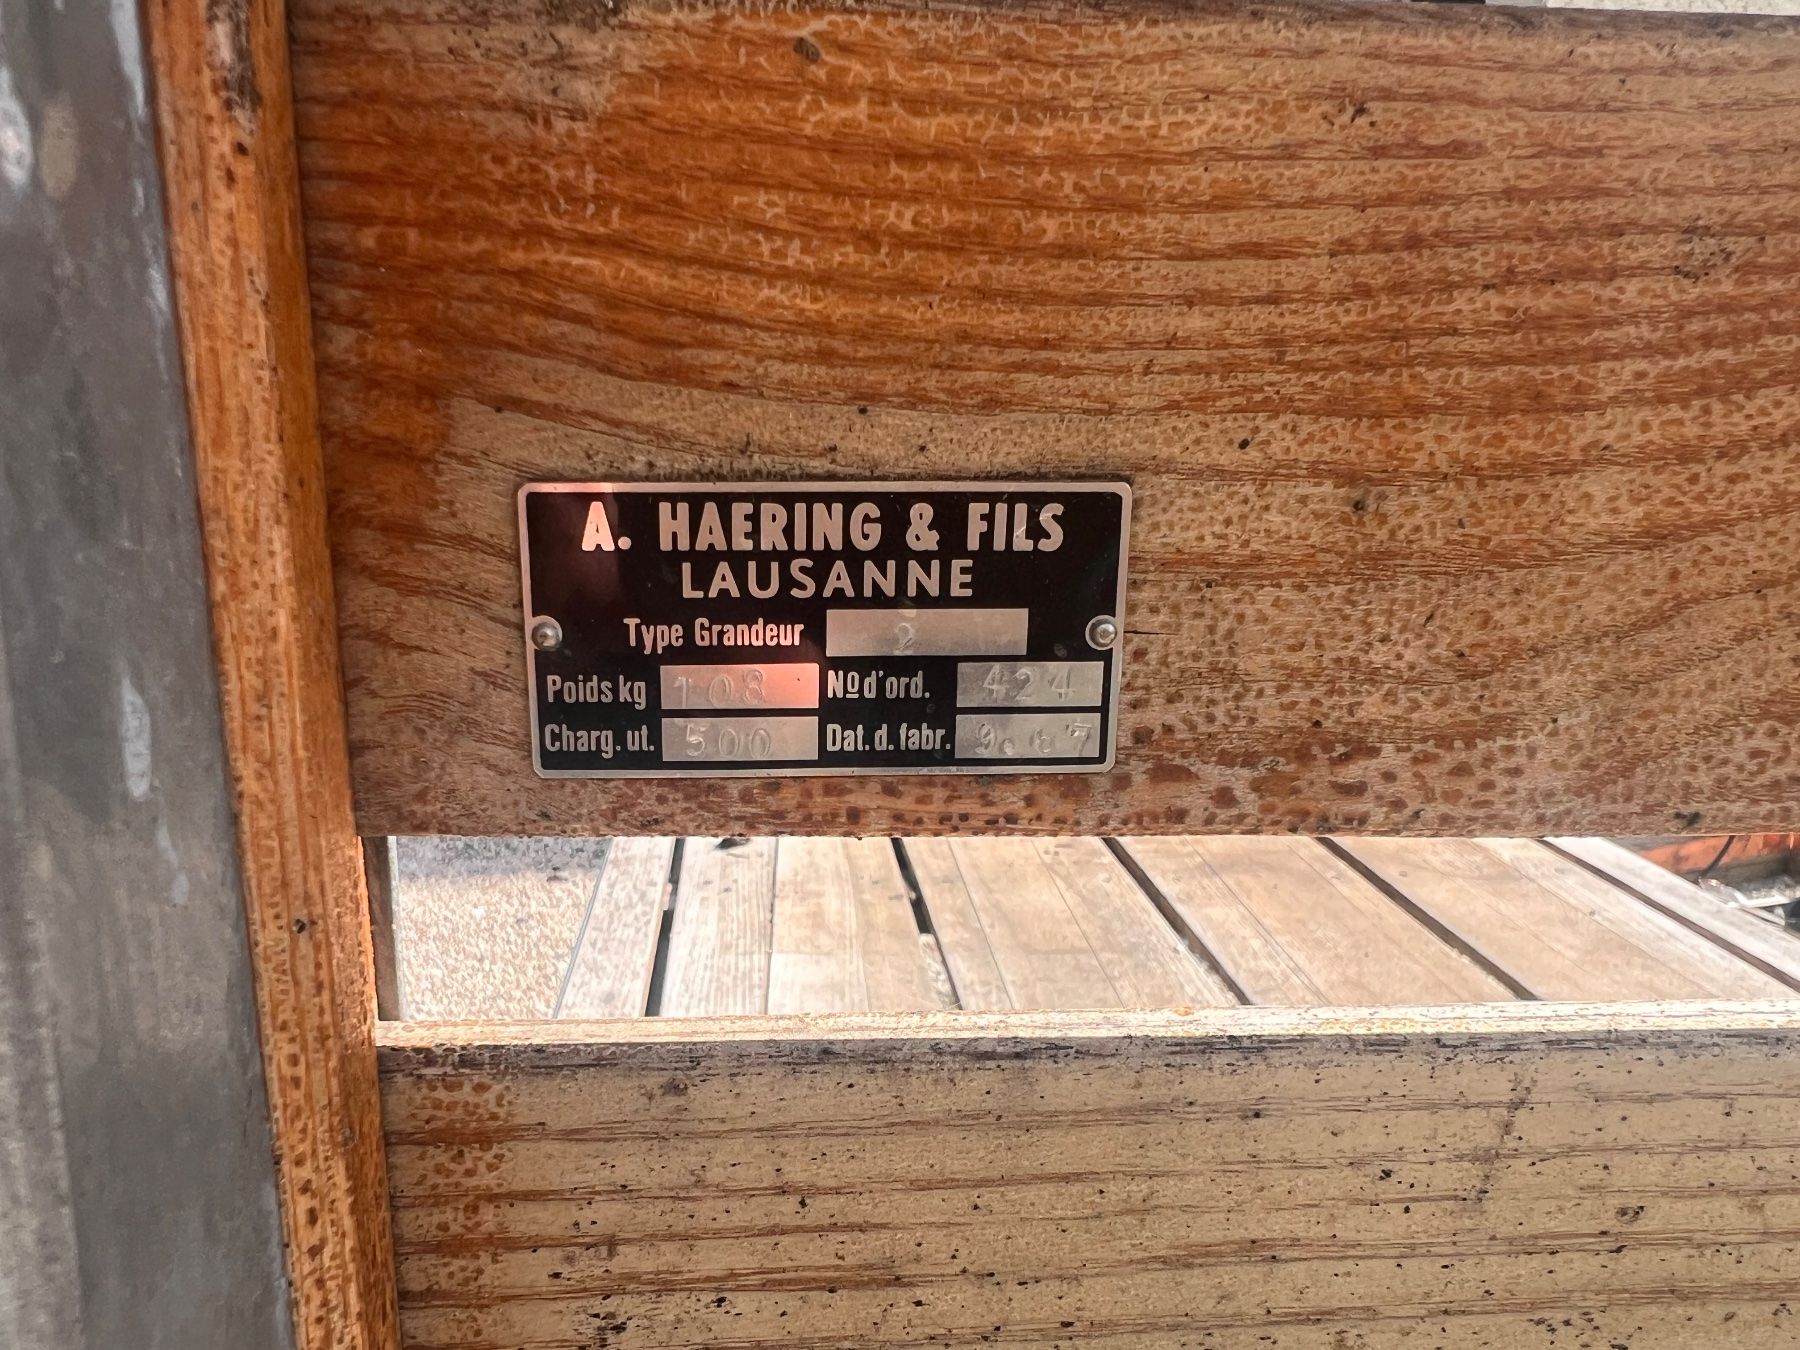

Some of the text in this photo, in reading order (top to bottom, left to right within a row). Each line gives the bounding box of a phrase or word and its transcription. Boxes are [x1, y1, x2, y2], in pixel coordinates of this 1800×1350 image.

[581, 501, 1065, 551] A. HAERING & FILS
[681, 558, 973, 599] LAUSANNE
[623, 617, 804, 654] Type Grandeur
[546, 674, 647, 710] Poids kg
[982, 664, 1077, 701] 424
[544, 723, 655, 759] Charg. ut.
[680, 722, 771, 758] 500
[826, 722, 951, 752] Dat. d. fabr.
